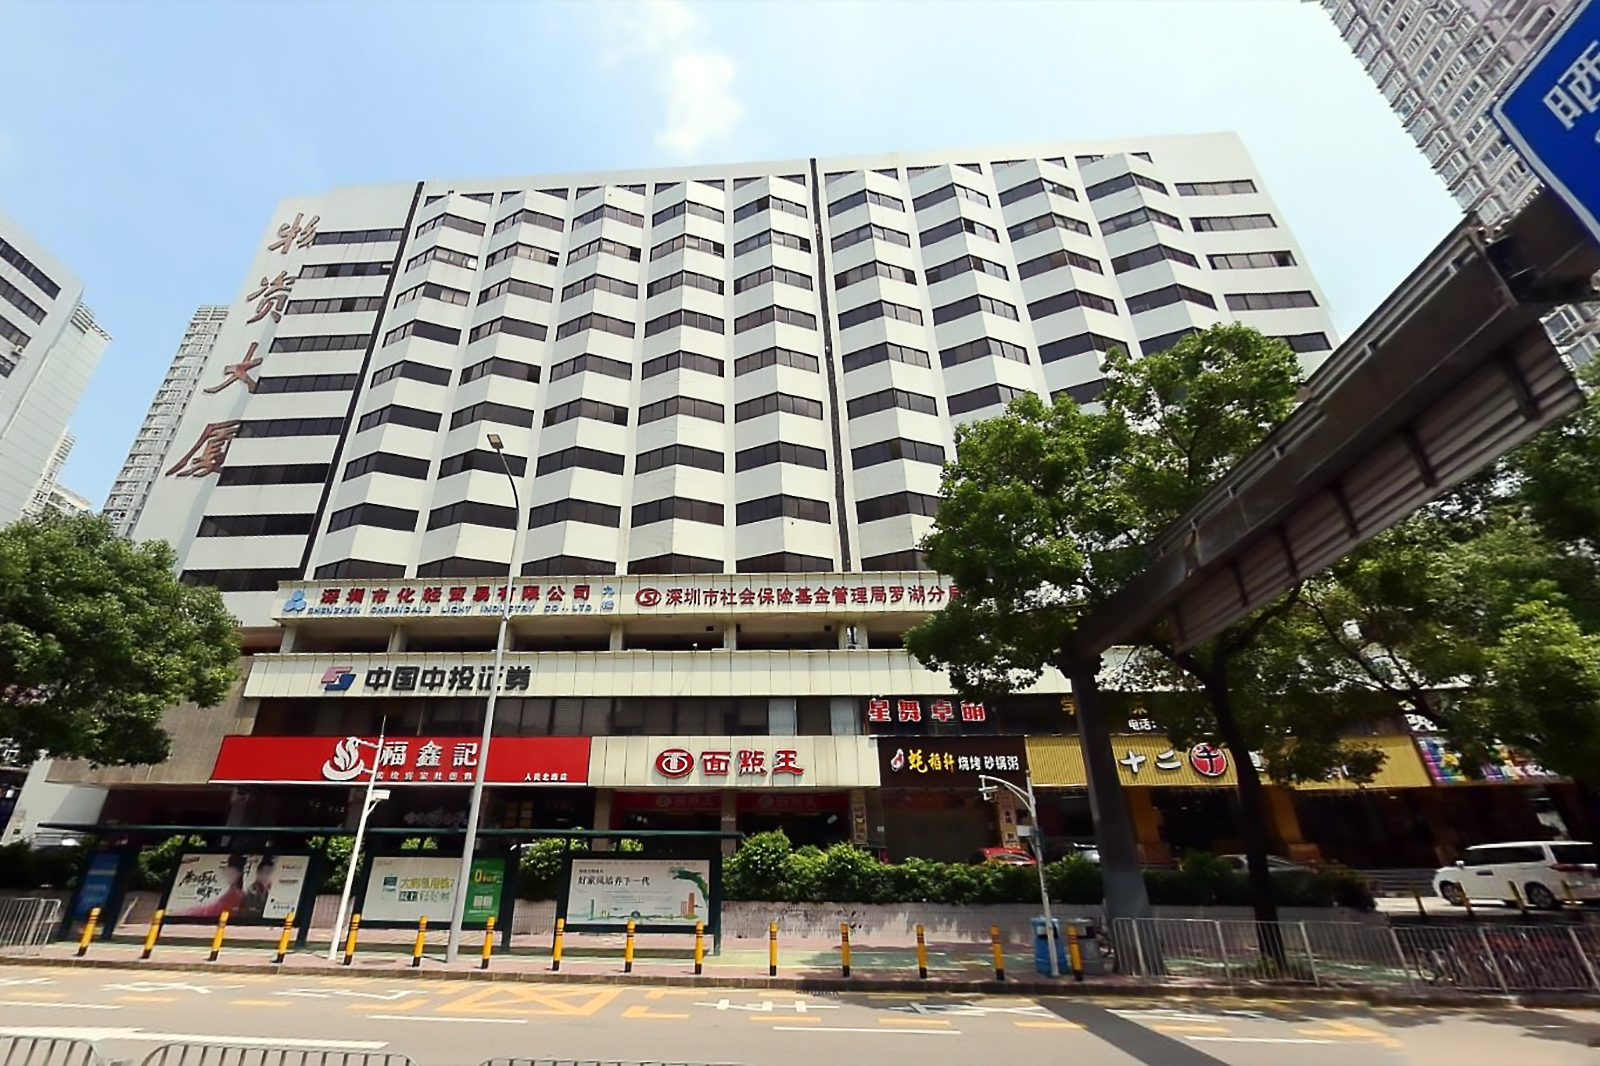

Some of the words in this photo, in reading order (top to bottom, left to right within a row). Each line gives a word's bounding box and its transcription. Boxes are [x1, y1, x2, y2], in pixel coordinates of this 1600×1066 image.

[165, 212, 320, 477] 物资大厦
[307, 607, 362, 615] SHENZHEN
[365, 665, 532, 691] 中国中投证券
